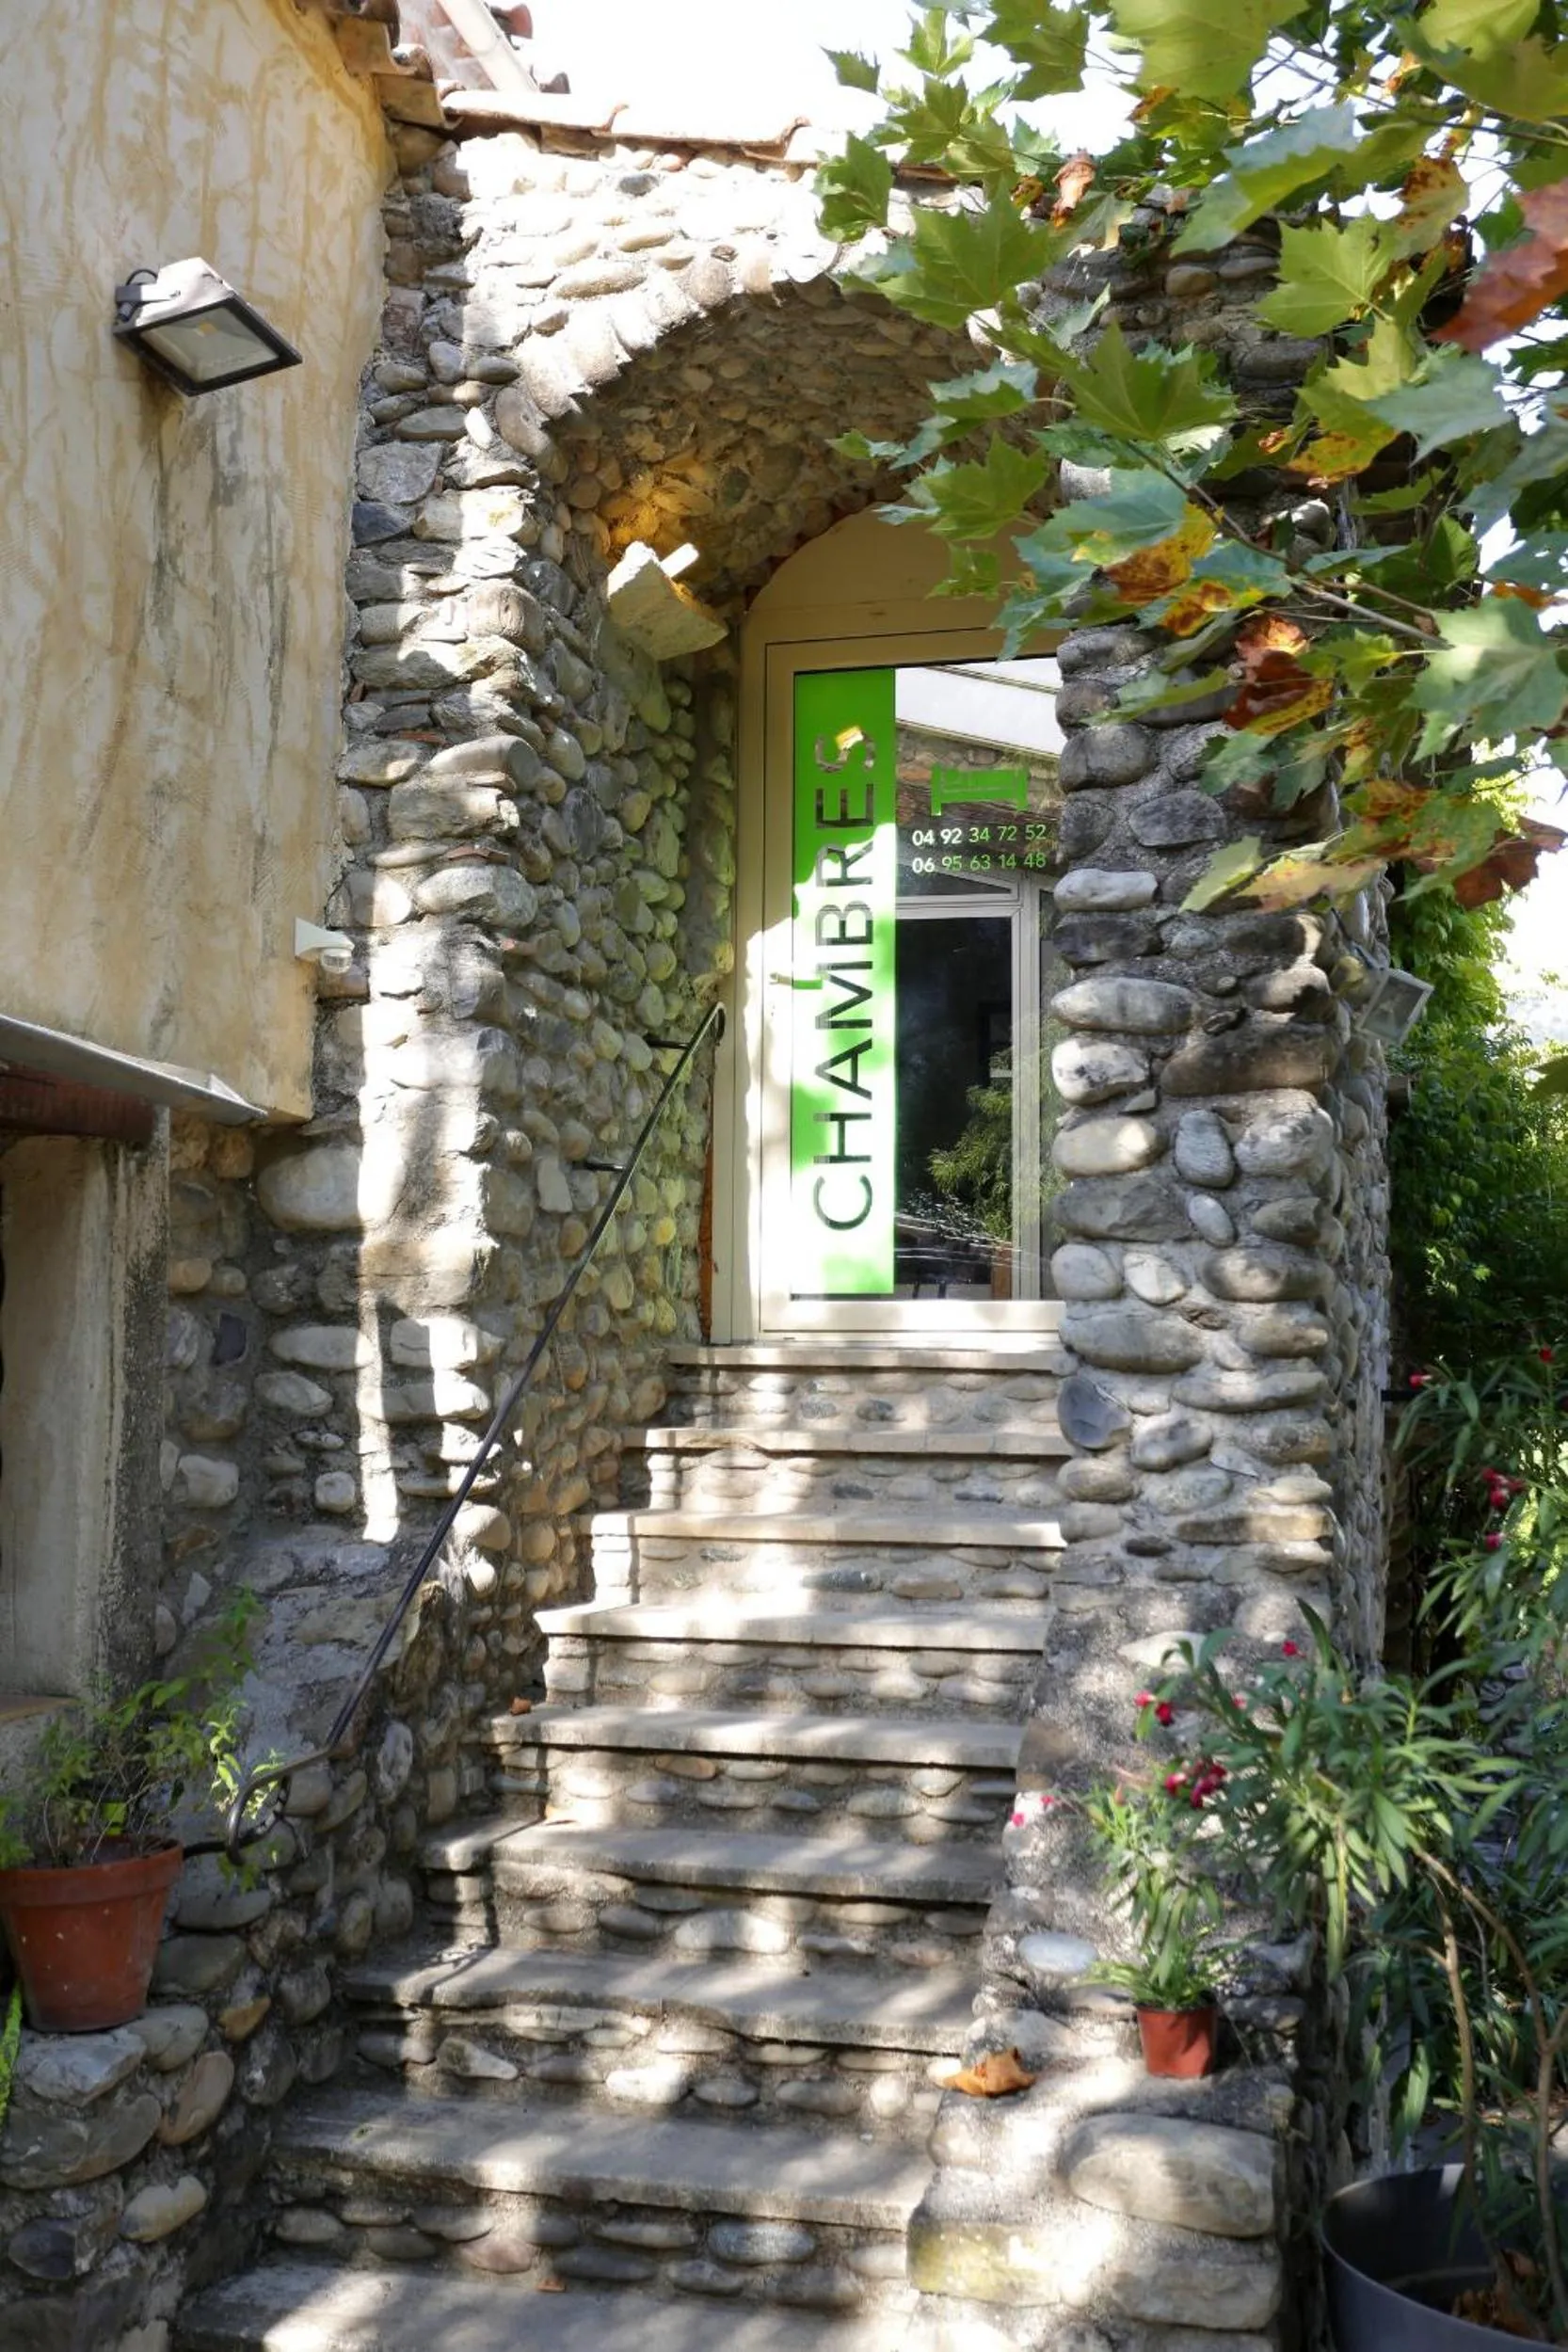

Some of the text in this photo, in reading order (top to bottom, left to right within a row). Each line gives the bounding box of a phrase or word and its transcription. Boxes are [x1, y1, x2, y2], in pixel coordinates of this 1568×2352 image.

[912, 824, 1047, 846] 04 92 34 72 52
[912, 853, 1047, 873] 06 95 63 14 48
[813, 728, 875, 1231] CHAMBRES
